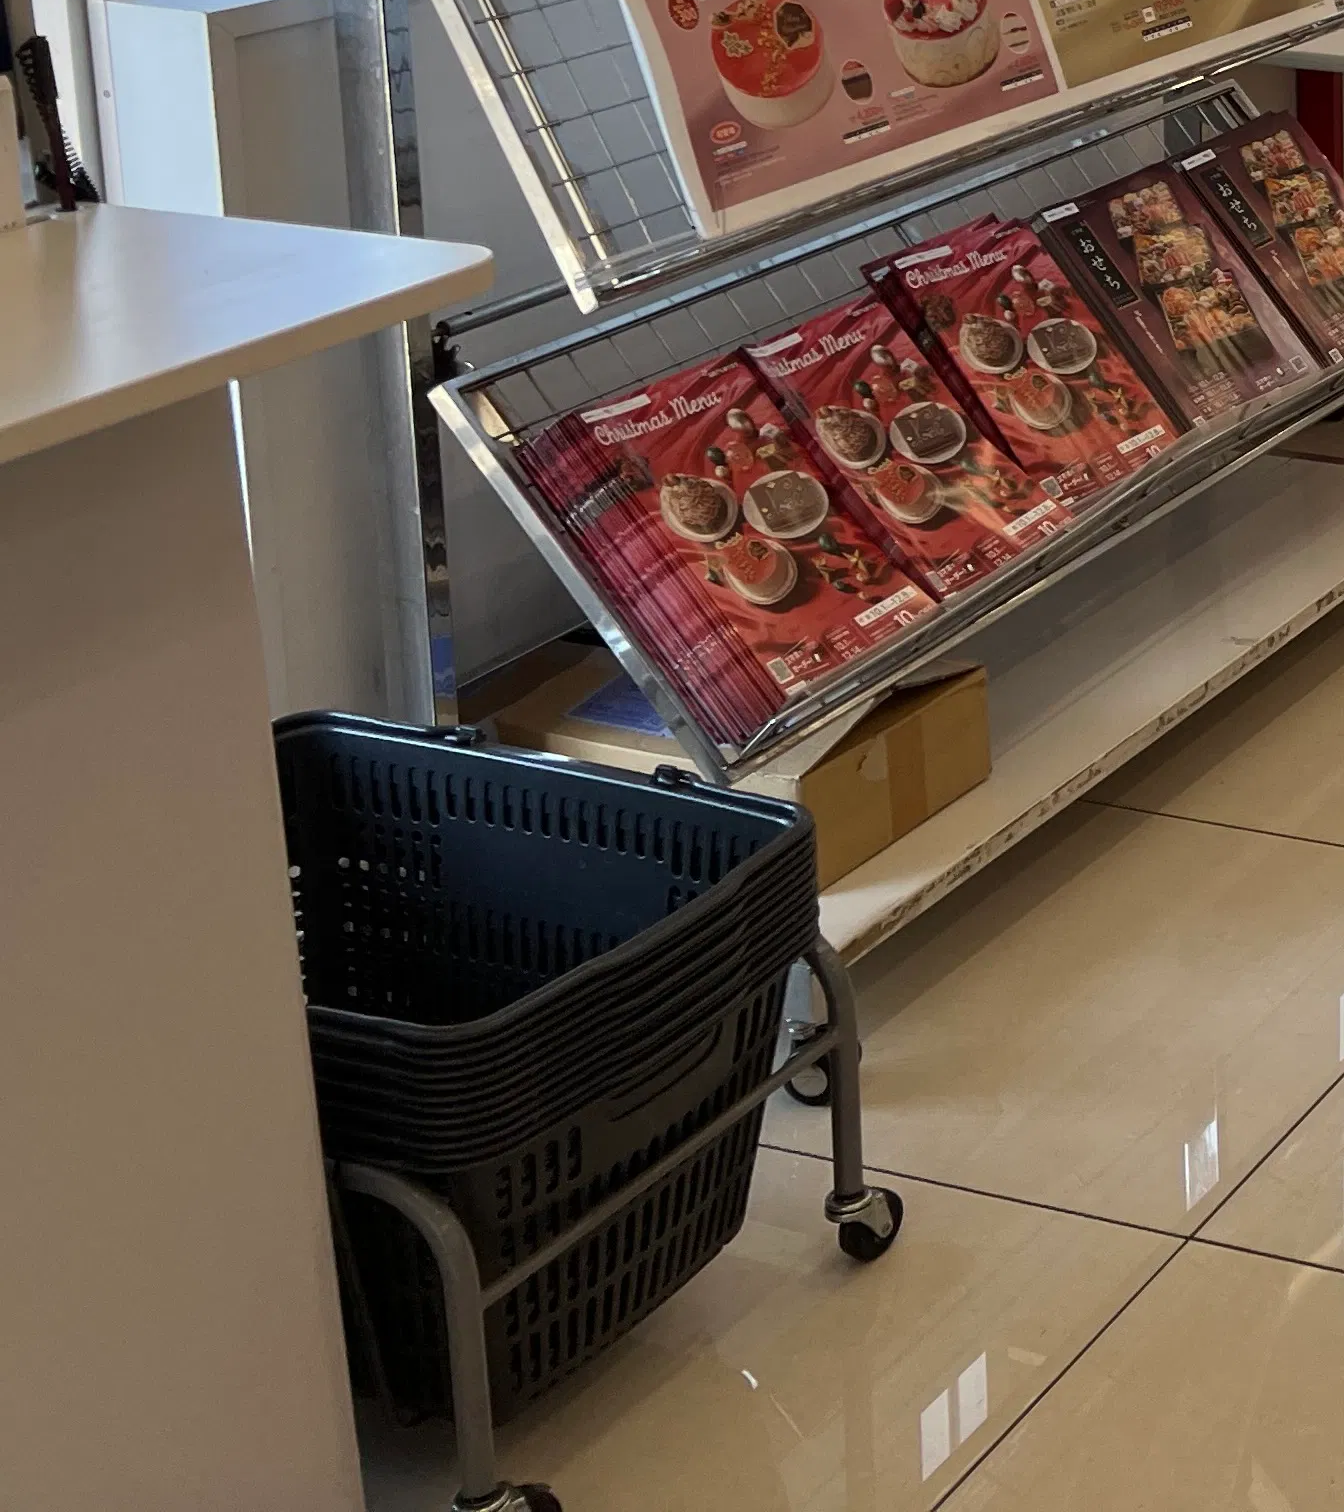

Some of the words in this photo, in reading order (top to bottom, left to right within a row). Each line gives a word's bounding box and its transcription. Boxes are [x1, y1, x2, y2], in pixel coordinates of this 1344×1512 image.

[1218, 183, 1258, 232] おせち
[905, 259, 969, 289] Christmas
[967, 249, 1008, 272] Menu
[1078, 238, 1121, 290] おせち
[819, 329, 865, 357] Menu
[594, 404, 672, 446] Christmas
[671, 391, 723, 422] Menu
[893, 609, 915, 627] 10
